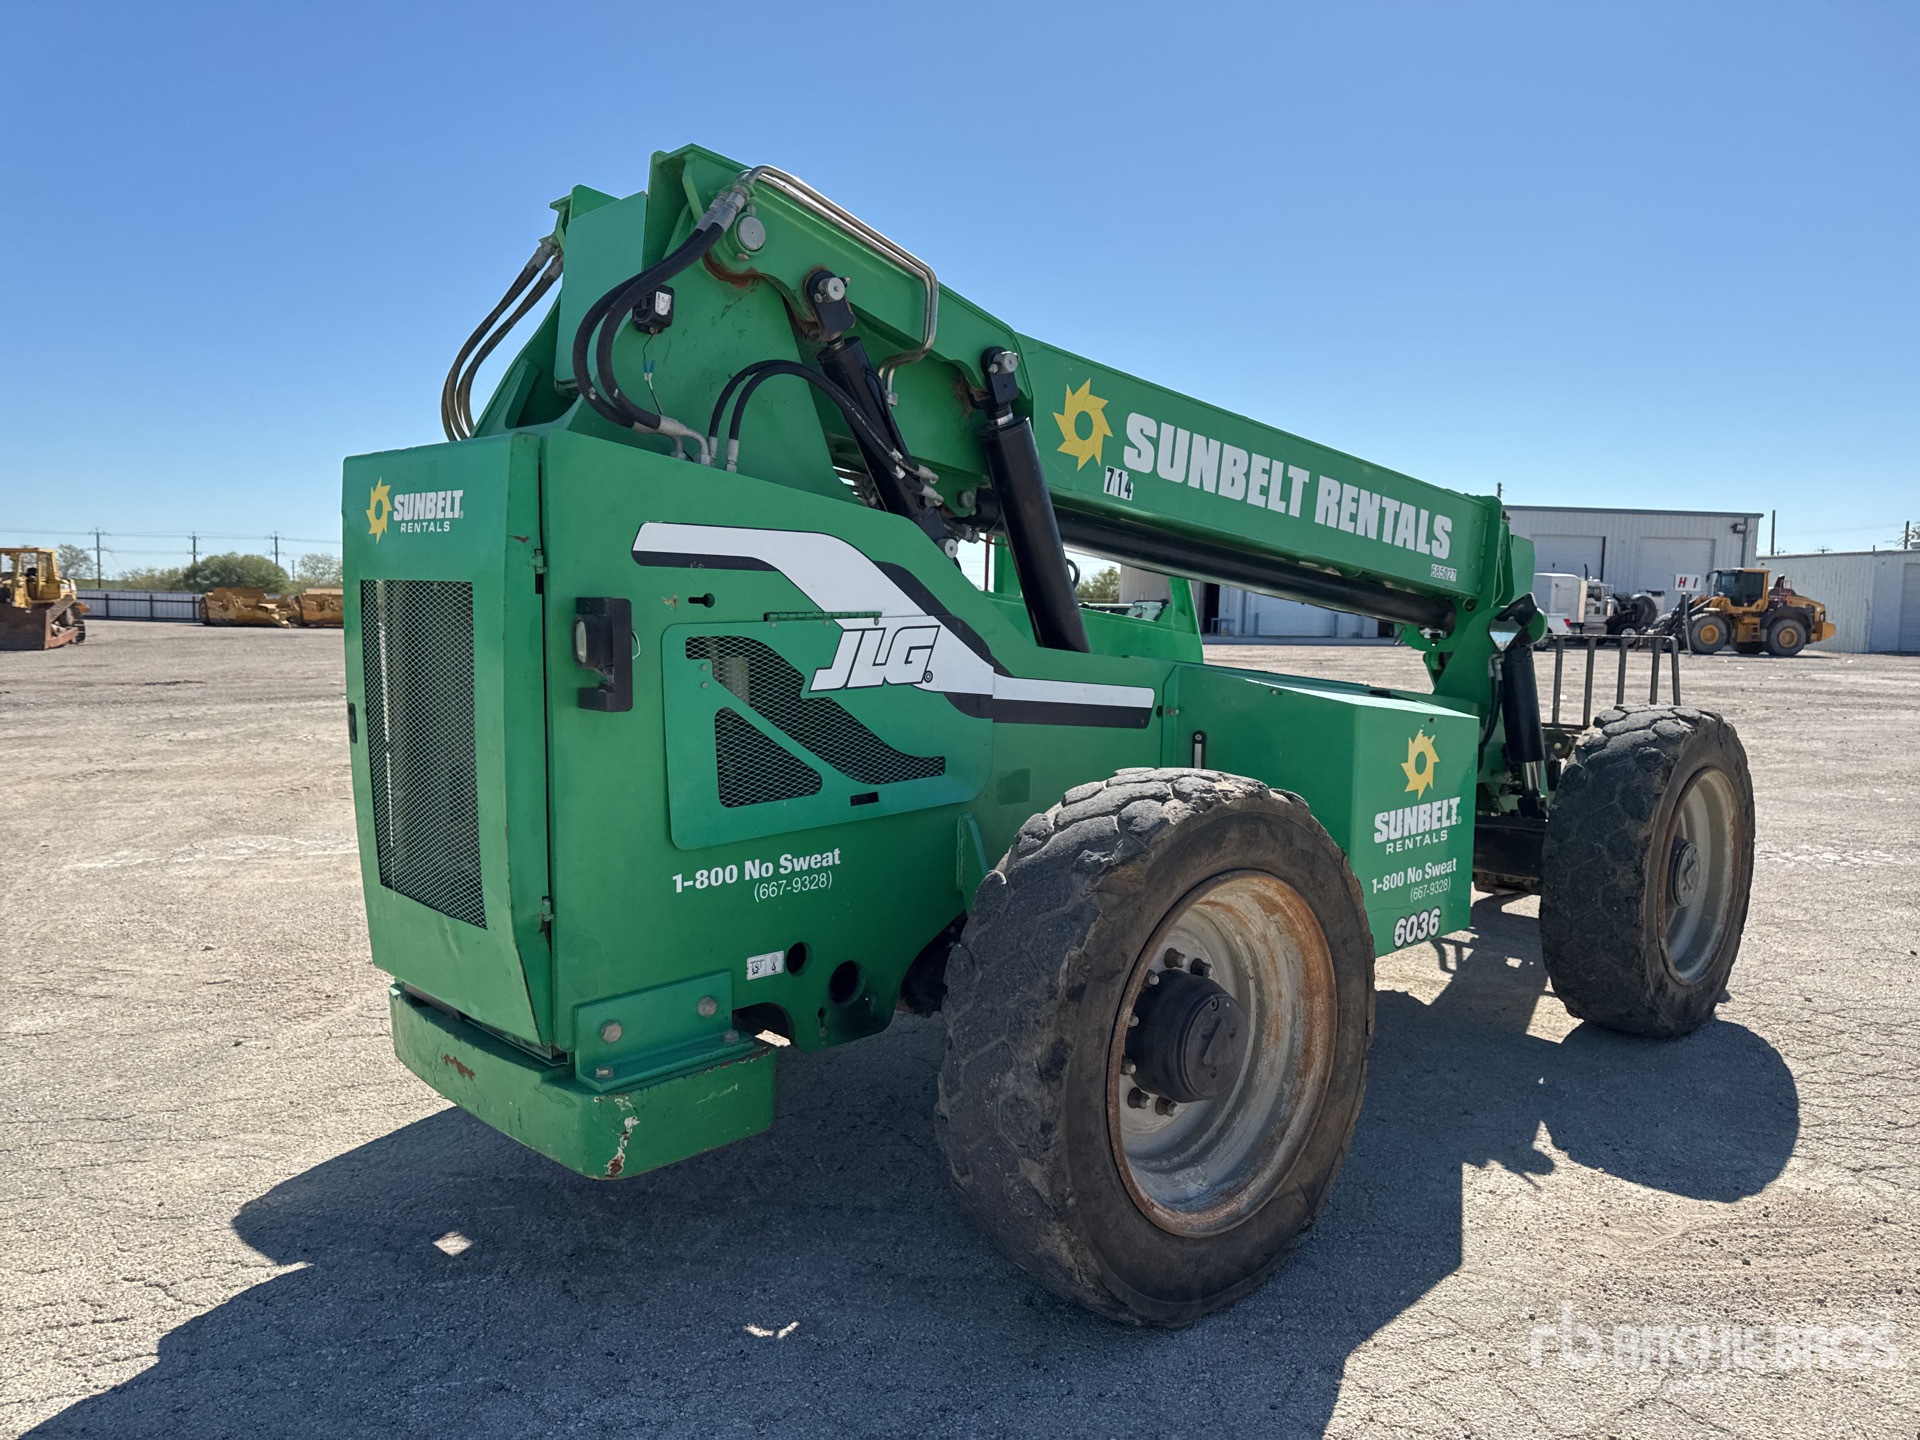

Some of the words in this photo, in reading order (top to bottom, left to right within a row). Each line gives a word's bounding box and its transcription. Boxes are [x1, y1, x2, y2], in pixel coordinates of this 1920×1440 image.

[1106, 466, 1132, 499] 714
[1123, 412, 1310, 518] SUNBELT
[1314, 475, 1452, 560] RENTALS
[393, 489, 463, 521] SUNBELT
[400, 521, 451, 533] RENTALS
[1431, 564, 1456, 581] 685027
[808, 625, 941, 693] JLG
[1373, 796, 1461, 844] SUNBELT
[1386, 829, 1448, 855] RENTALS
[672, 864, 738, 893] 1-800
[744, 859, 774, 881] No
[779, 847, 841, 875] Sweat
[754, 870, 833, 903] (667-9328)
[1371, 871, 1405, 895] 1-800
[1407, 866, 1423, 884] No
[1424, 857, 1457, 881] Sweat
[1410, 876, 1452, 903] (667-9328)
[1393, 906, 1442, 949] 6036
